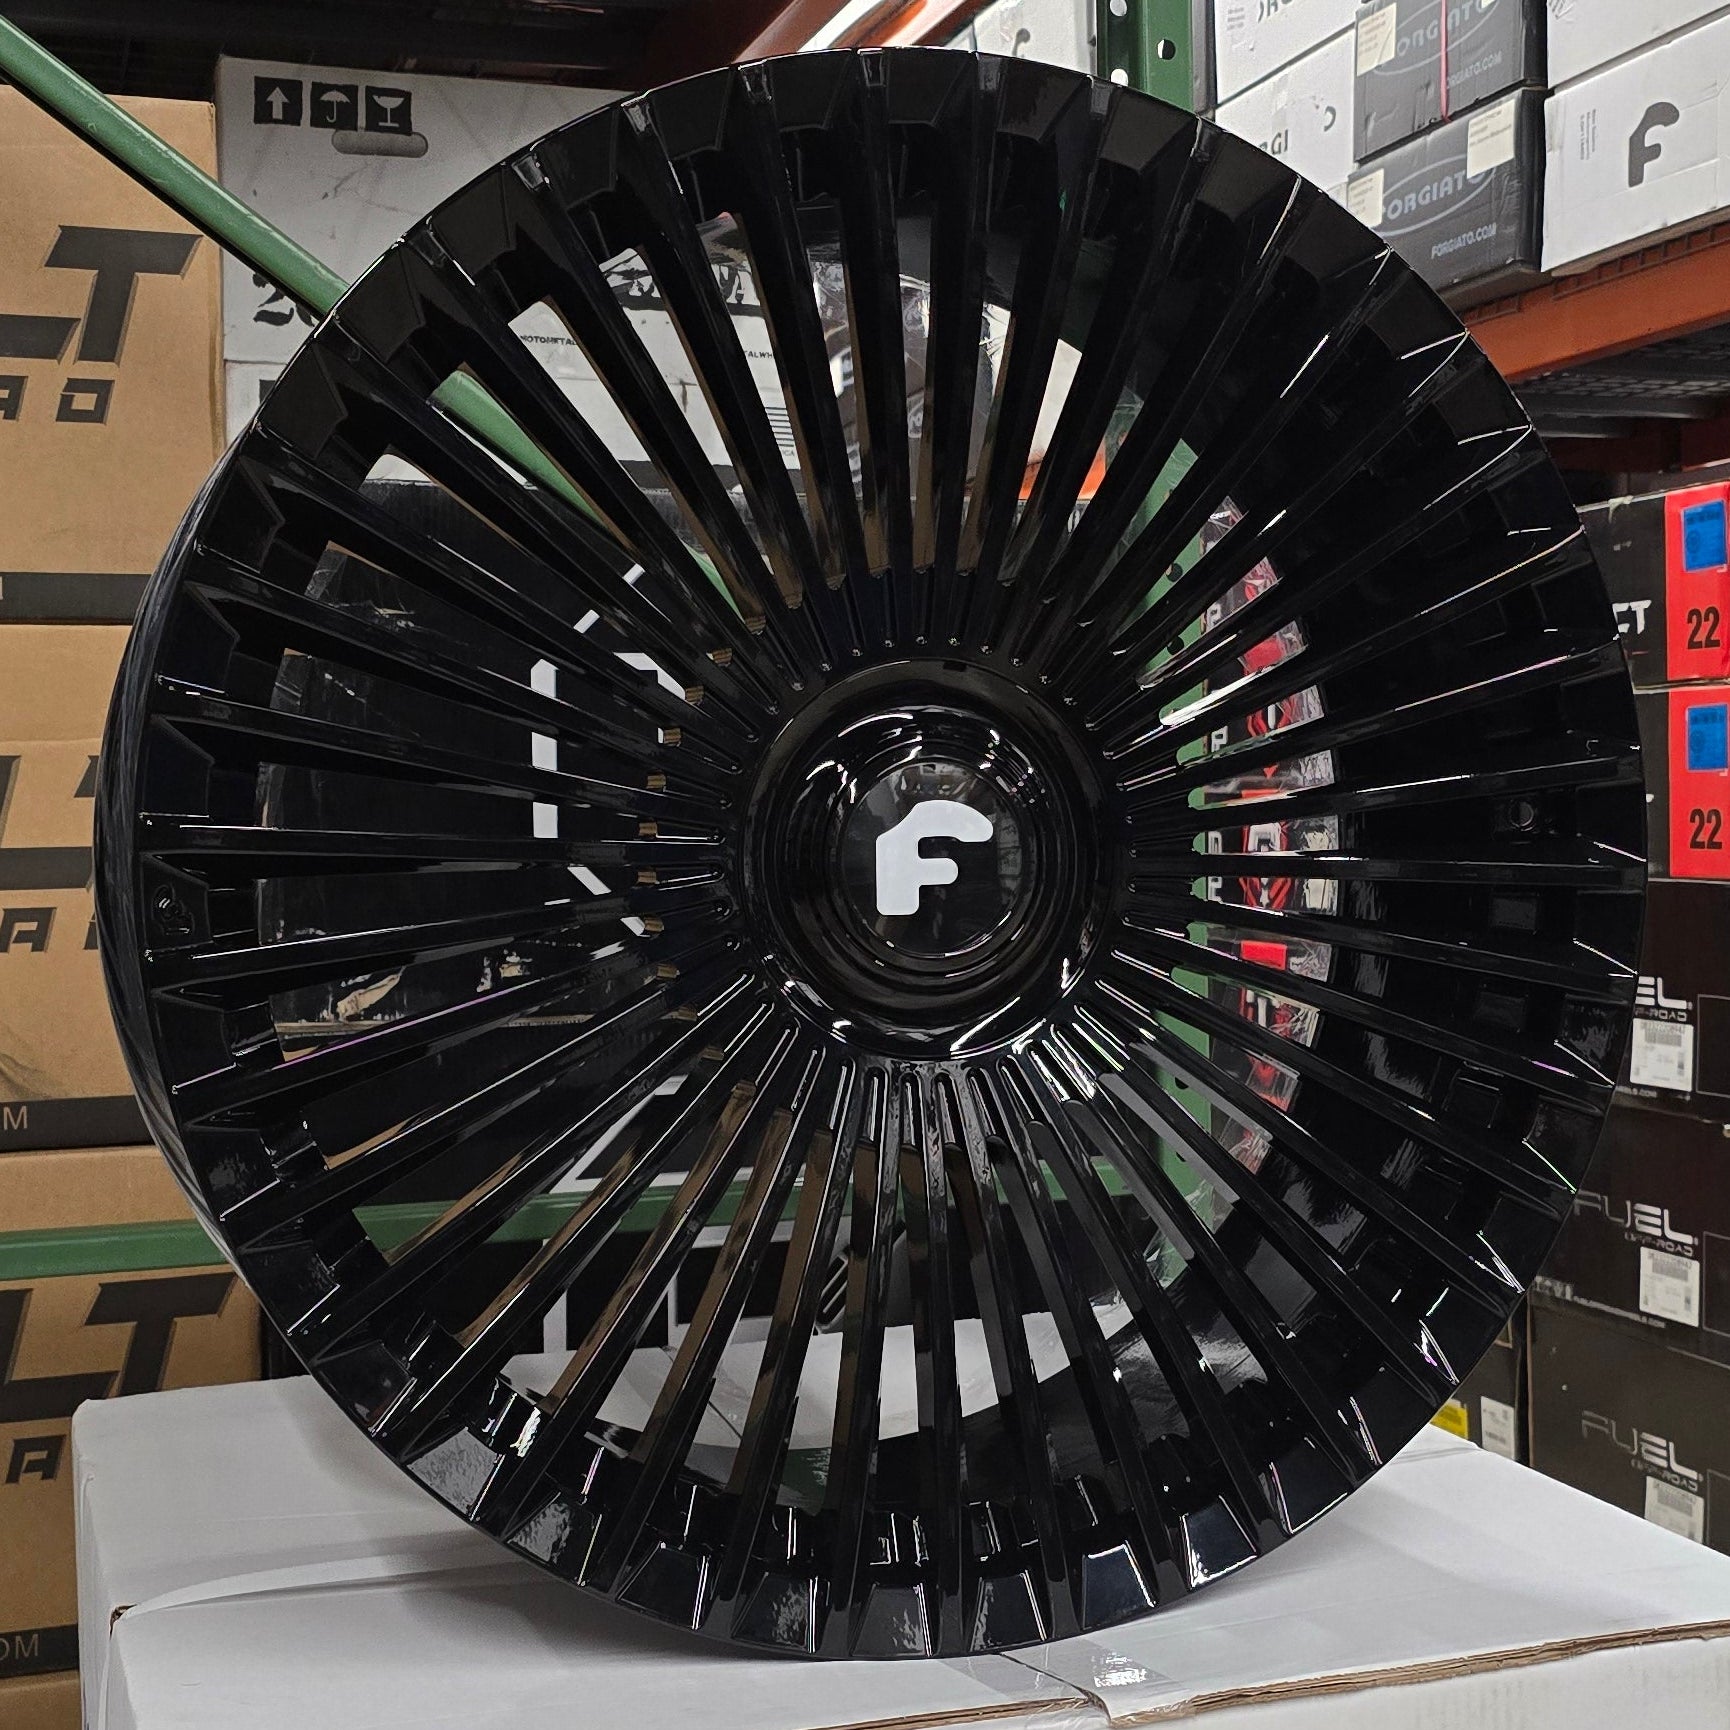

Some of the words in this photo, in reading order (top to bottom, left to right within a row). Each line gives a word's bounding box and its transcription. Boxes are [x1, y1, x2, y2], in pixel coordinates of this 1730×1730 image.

[1628, 101, 1680, 188] F
[1382, 168, 1487, 220] ORGIAT
[1431, 222, 1498, 259] FORGIATO.COM
[1687, 606, 1721, 649] 22
[1689, 808, 1723, 850] 22
[875, 799, 994, 916] F
[1635, 976, 1688, 1011] EL
[1573, 1189, 1694, 1246] FUEL
[1581, 1410, 1699, 1481] FUEL
